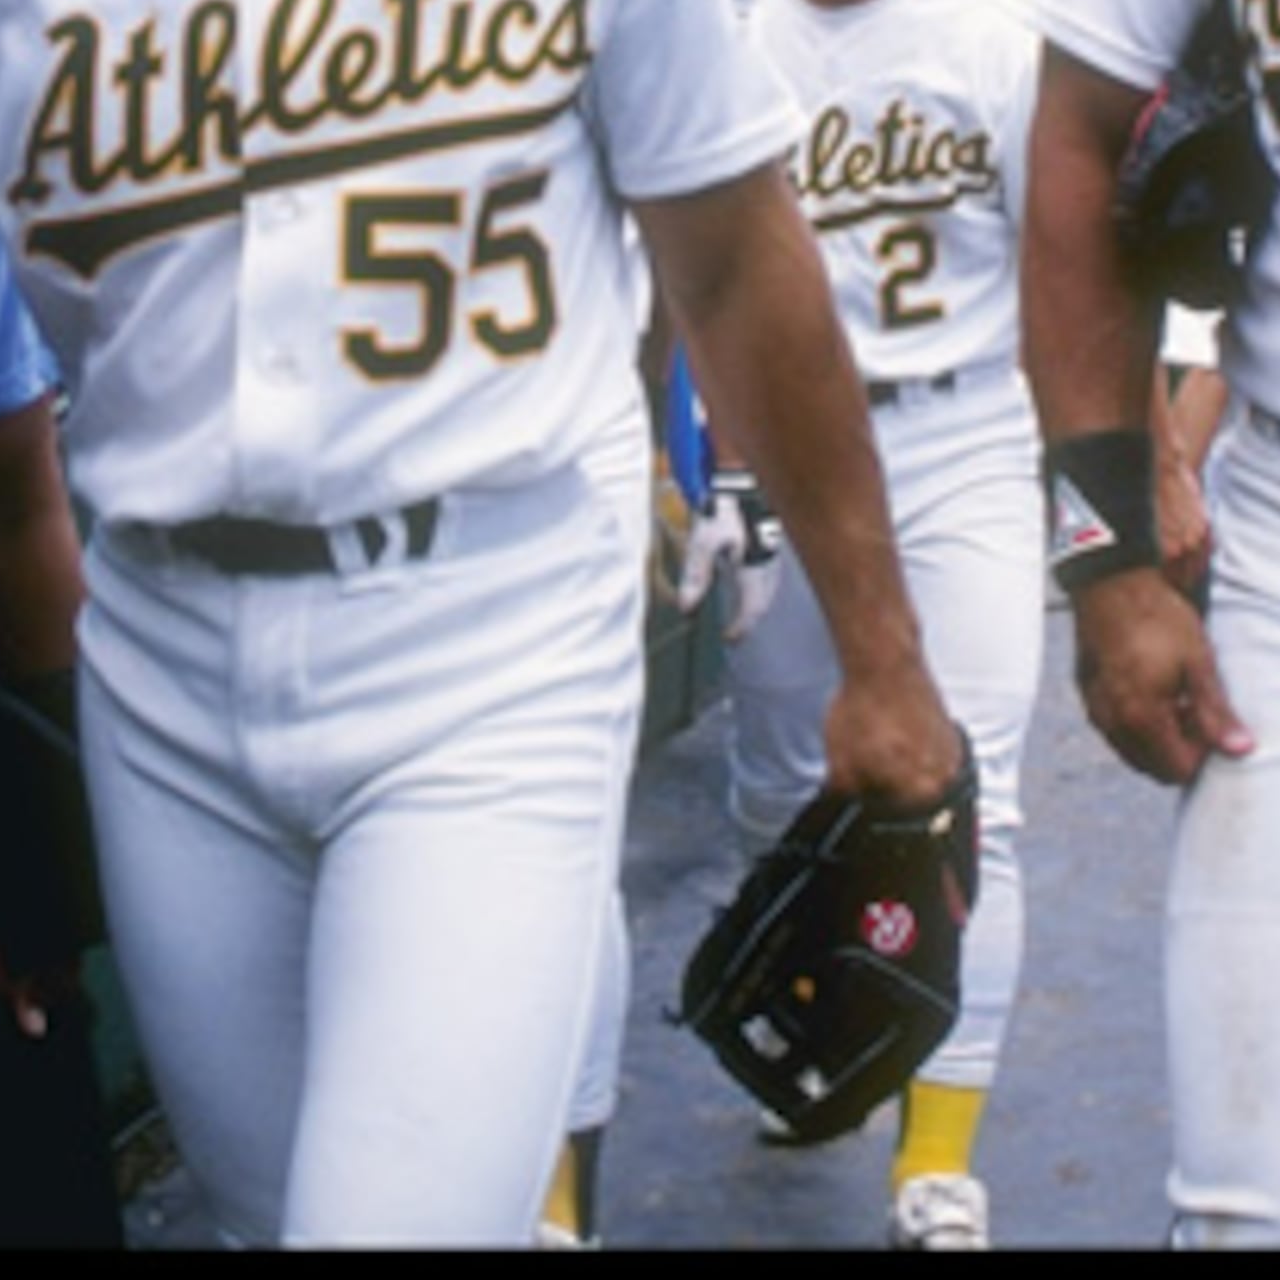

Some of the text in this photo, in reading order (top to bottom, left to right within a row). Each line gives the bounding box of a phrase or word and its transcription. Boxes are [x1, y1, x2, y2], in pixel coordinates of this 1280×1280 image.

[788, 98, 994, 198] letics
[339, 170, 558, 385] 55
[875, 223, 945, 332] 2
